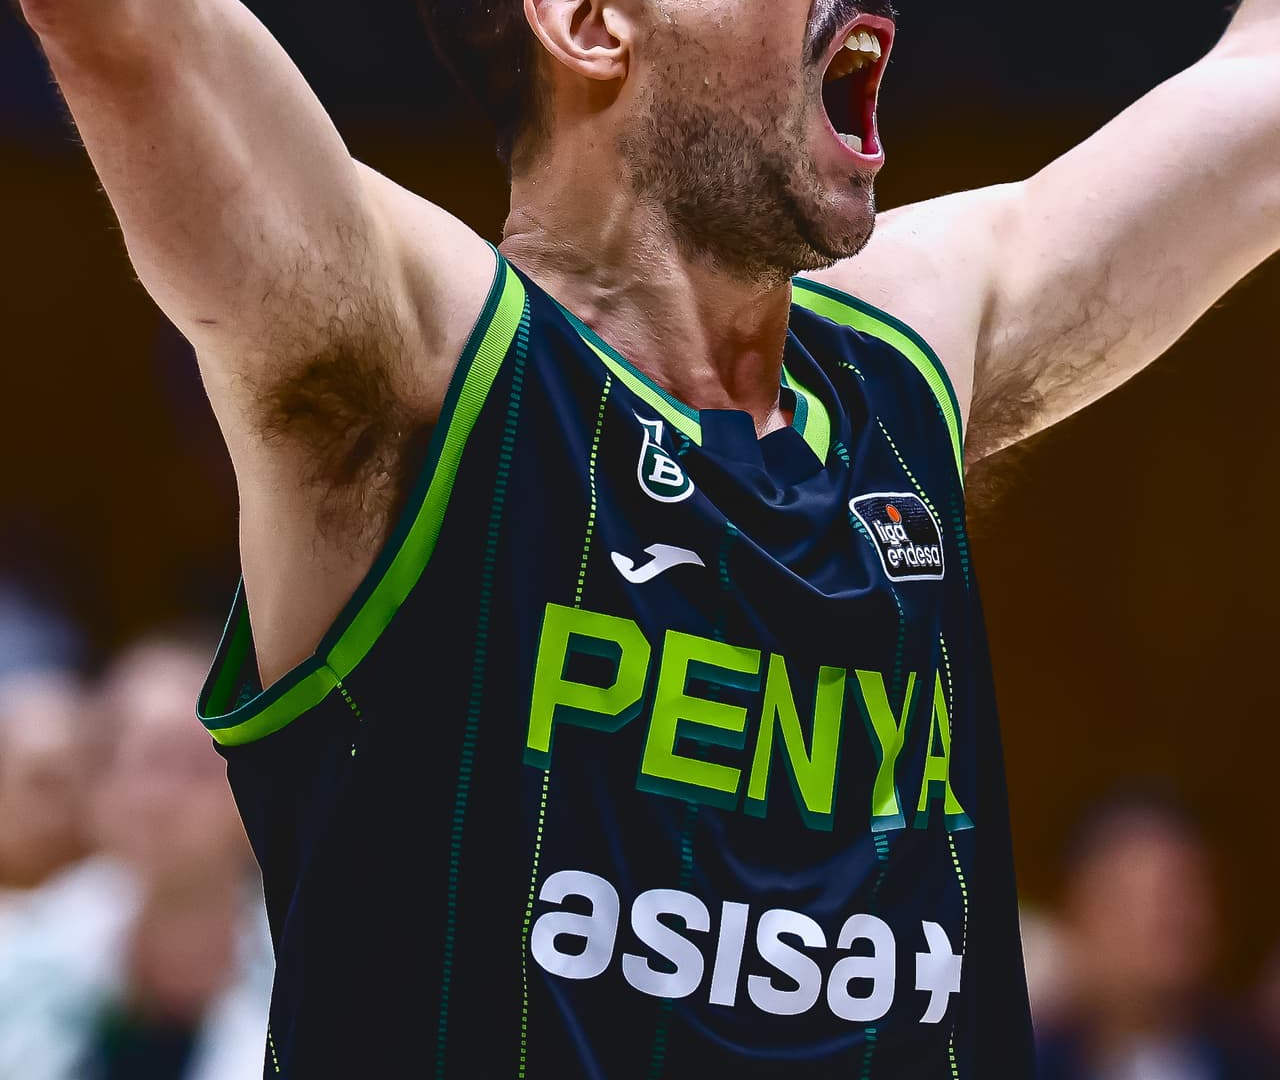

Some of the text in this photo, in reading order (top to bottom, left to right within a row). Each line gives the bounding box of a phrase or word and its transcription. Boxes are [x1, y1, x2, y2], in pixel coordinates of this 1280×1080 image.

[648, 453, 684, 487] B
[873, 519, 908, 545] liga
[887, 542, 940, 567] endesa
[524, 602, 975, 831] PENYA
